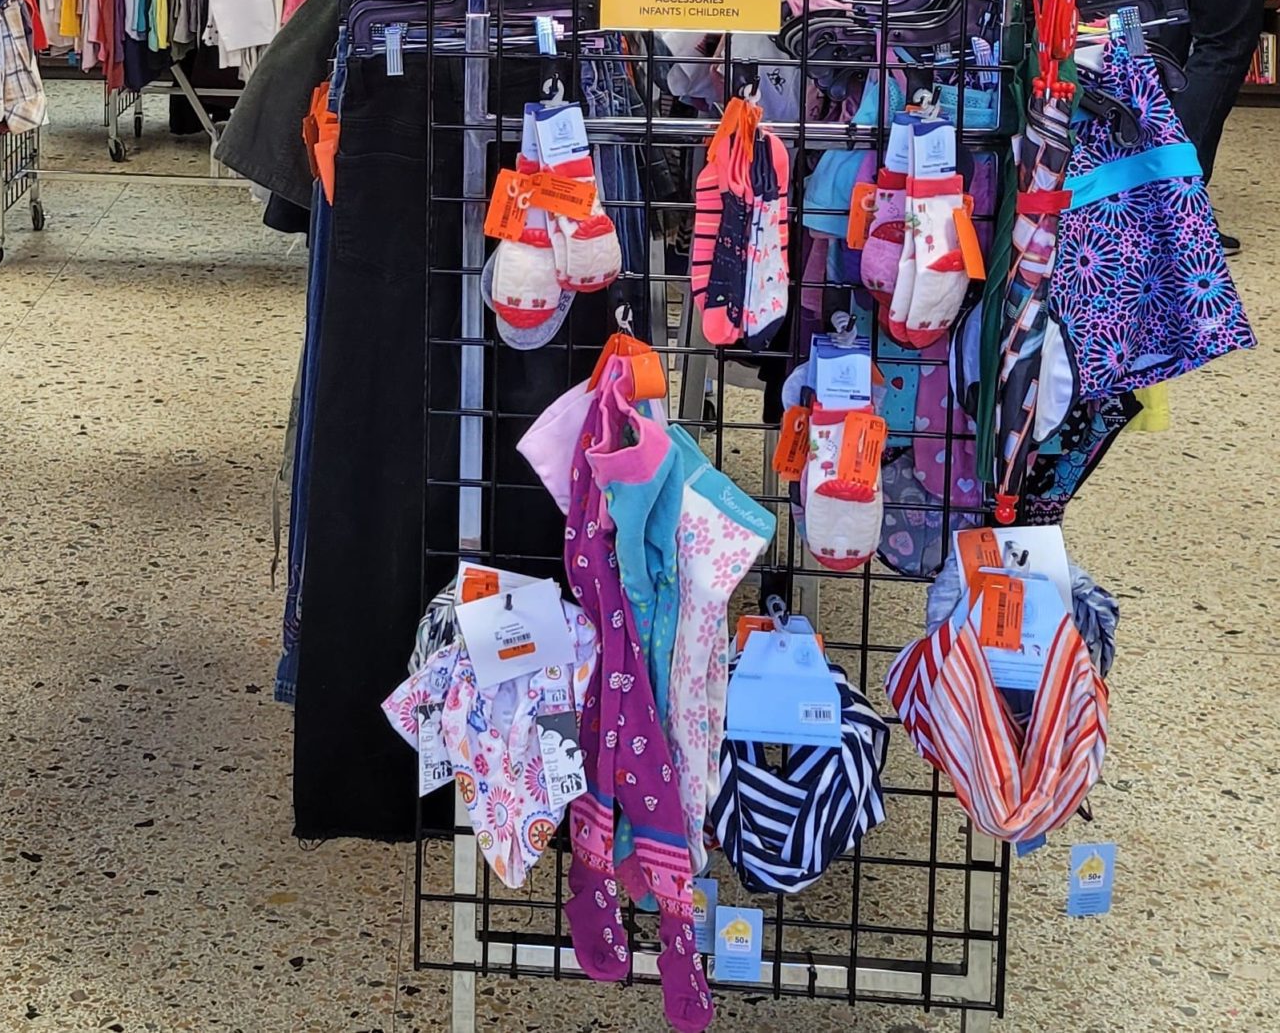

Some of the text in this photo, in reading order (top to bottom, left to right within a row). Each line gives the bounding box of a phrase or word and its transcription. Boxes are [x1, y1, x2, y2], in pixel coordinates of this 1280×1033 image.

[639, 6, 739, 17] INFANTS CHILDREN
[734, 936, 748, 944] 50+
